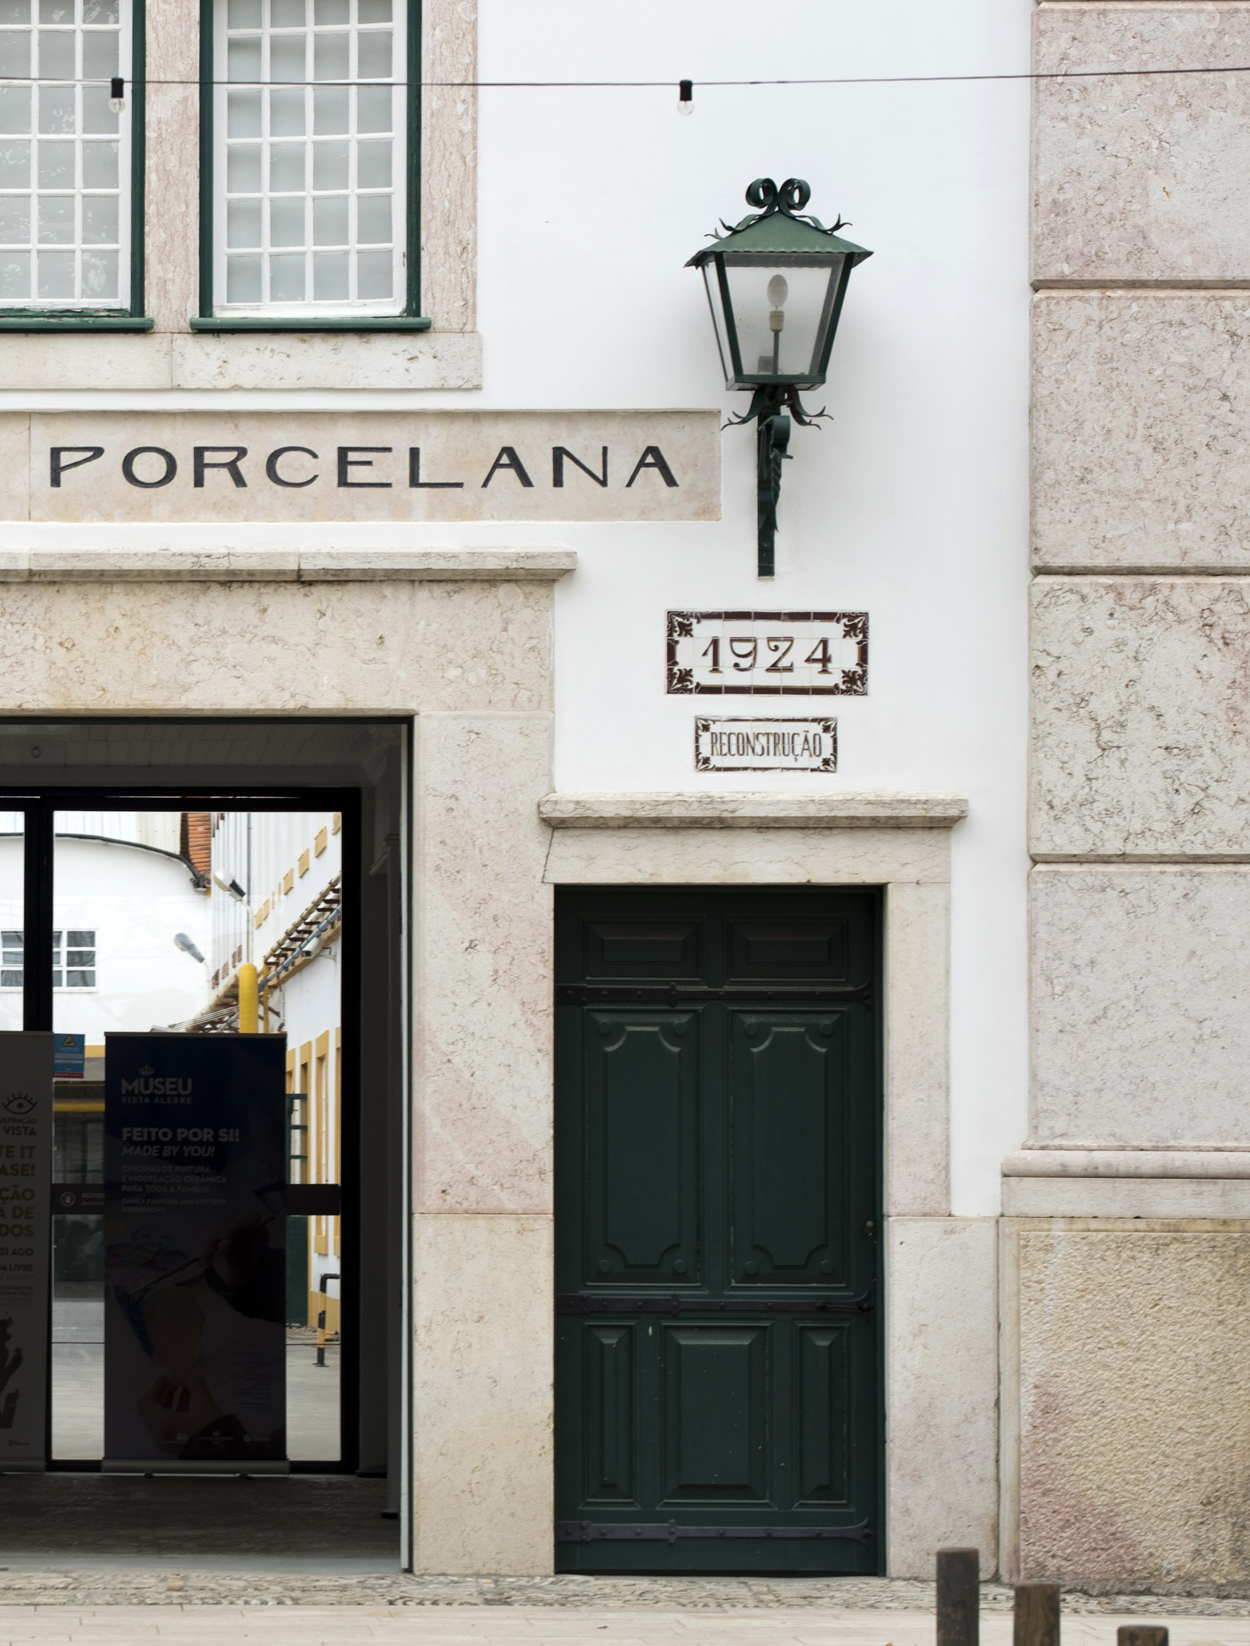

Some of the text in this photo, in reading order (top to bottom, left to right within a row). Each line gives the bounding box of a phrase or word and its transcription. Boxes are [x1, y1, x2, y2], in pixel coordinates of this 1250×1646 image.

[49, 446, 680, 489] PORCELANA
[701, 636, 834, 675] 1924
[710, 730, 823, 762] RECONSTRUÇÃO
[121, 1077, 193, 1095] MUSEU
[121, 1096, 193, 1104] VISTA ALEGRE
[3, 1126, 37, 1136] VISTA
[122, 1127, 240, 1142] FEITO POR SI!
[21, 1145, 36, 1159] IT
[121, 1145, 216, 1157] MADE BY YOU!
[11, 1206, 35, 1219] DE
[11, 1248, 34, 1256] AGO
